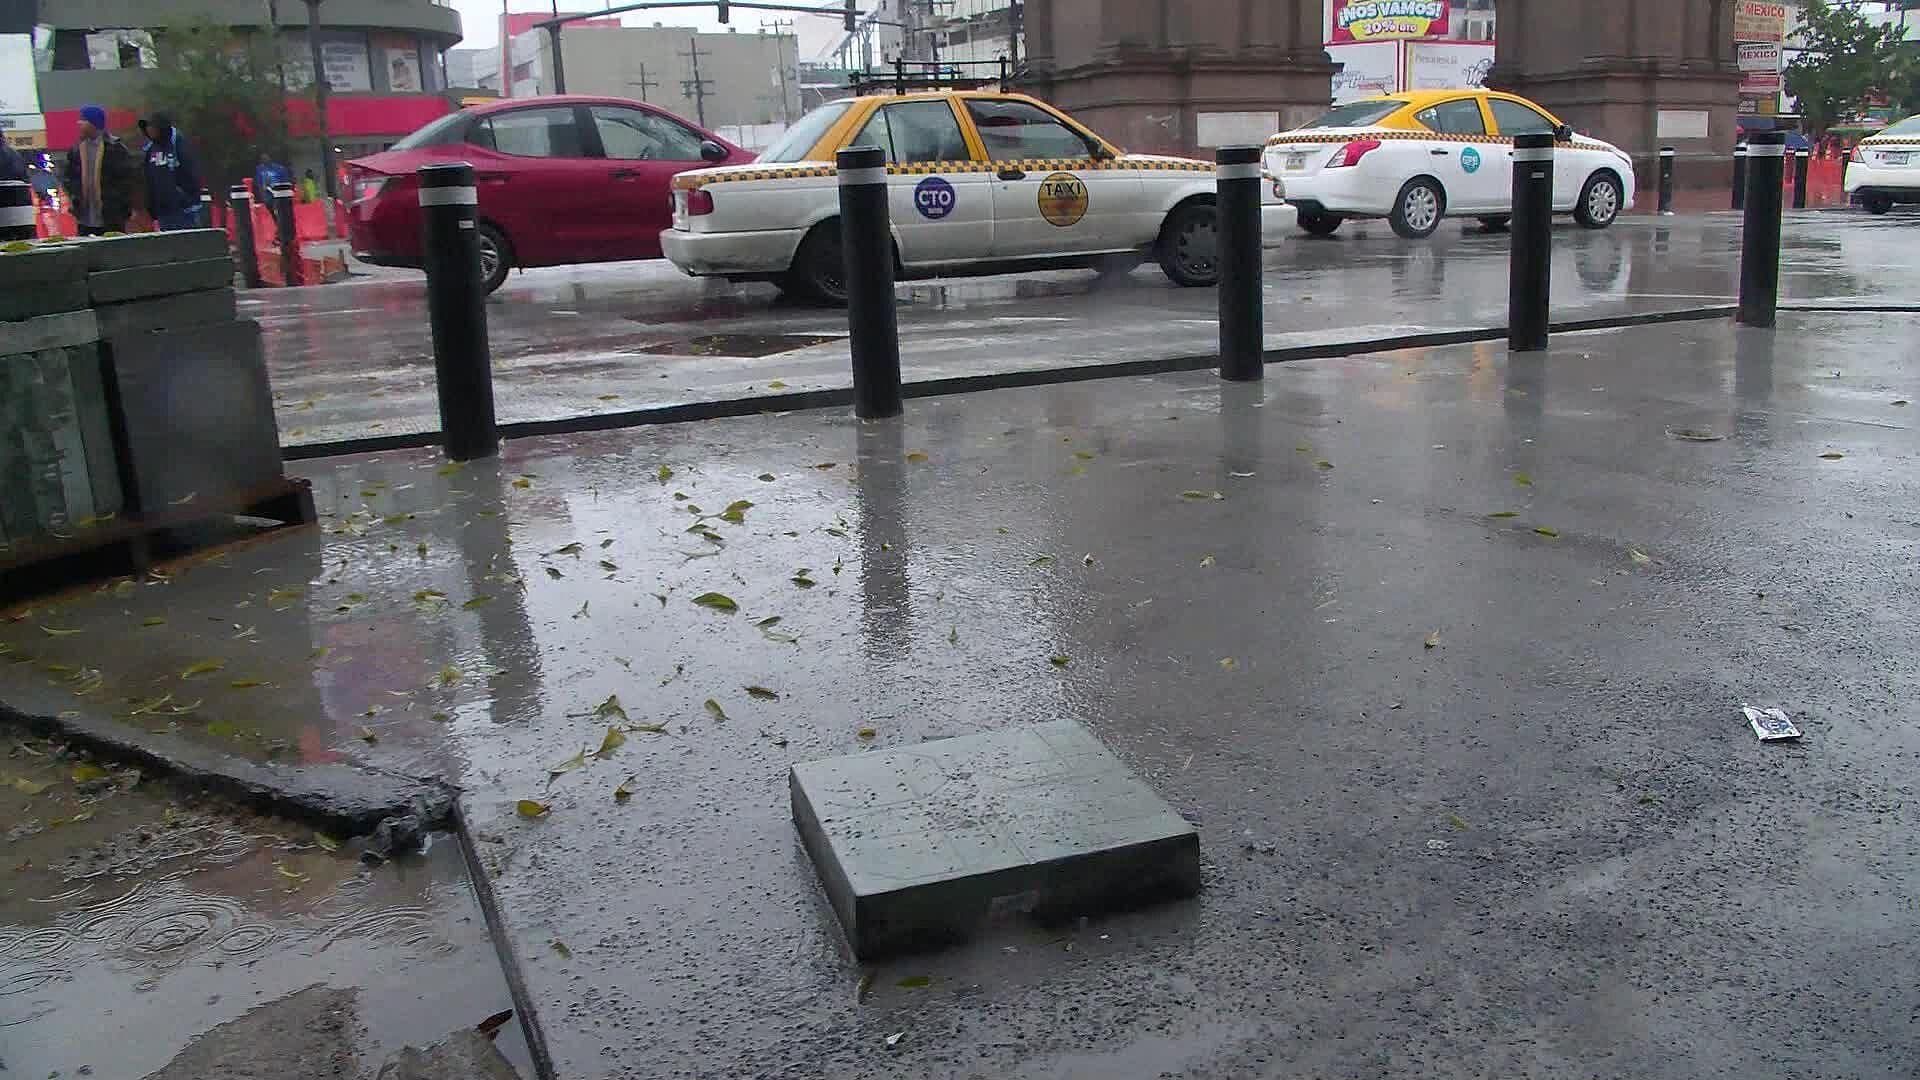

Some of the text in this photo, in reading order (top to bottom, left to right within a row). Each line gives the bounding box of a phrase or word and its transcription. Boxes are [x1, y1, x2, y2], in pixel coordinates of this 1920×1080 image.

[1379, 1, 1442, 18] VAMOS!
[1744, 3, 1785, 18] MEXICO
[1740, 50, 1778, 60] MEXICO
[918, 190, 952, 206] CTO
[1045, 182, 1082, 198] TAXI
